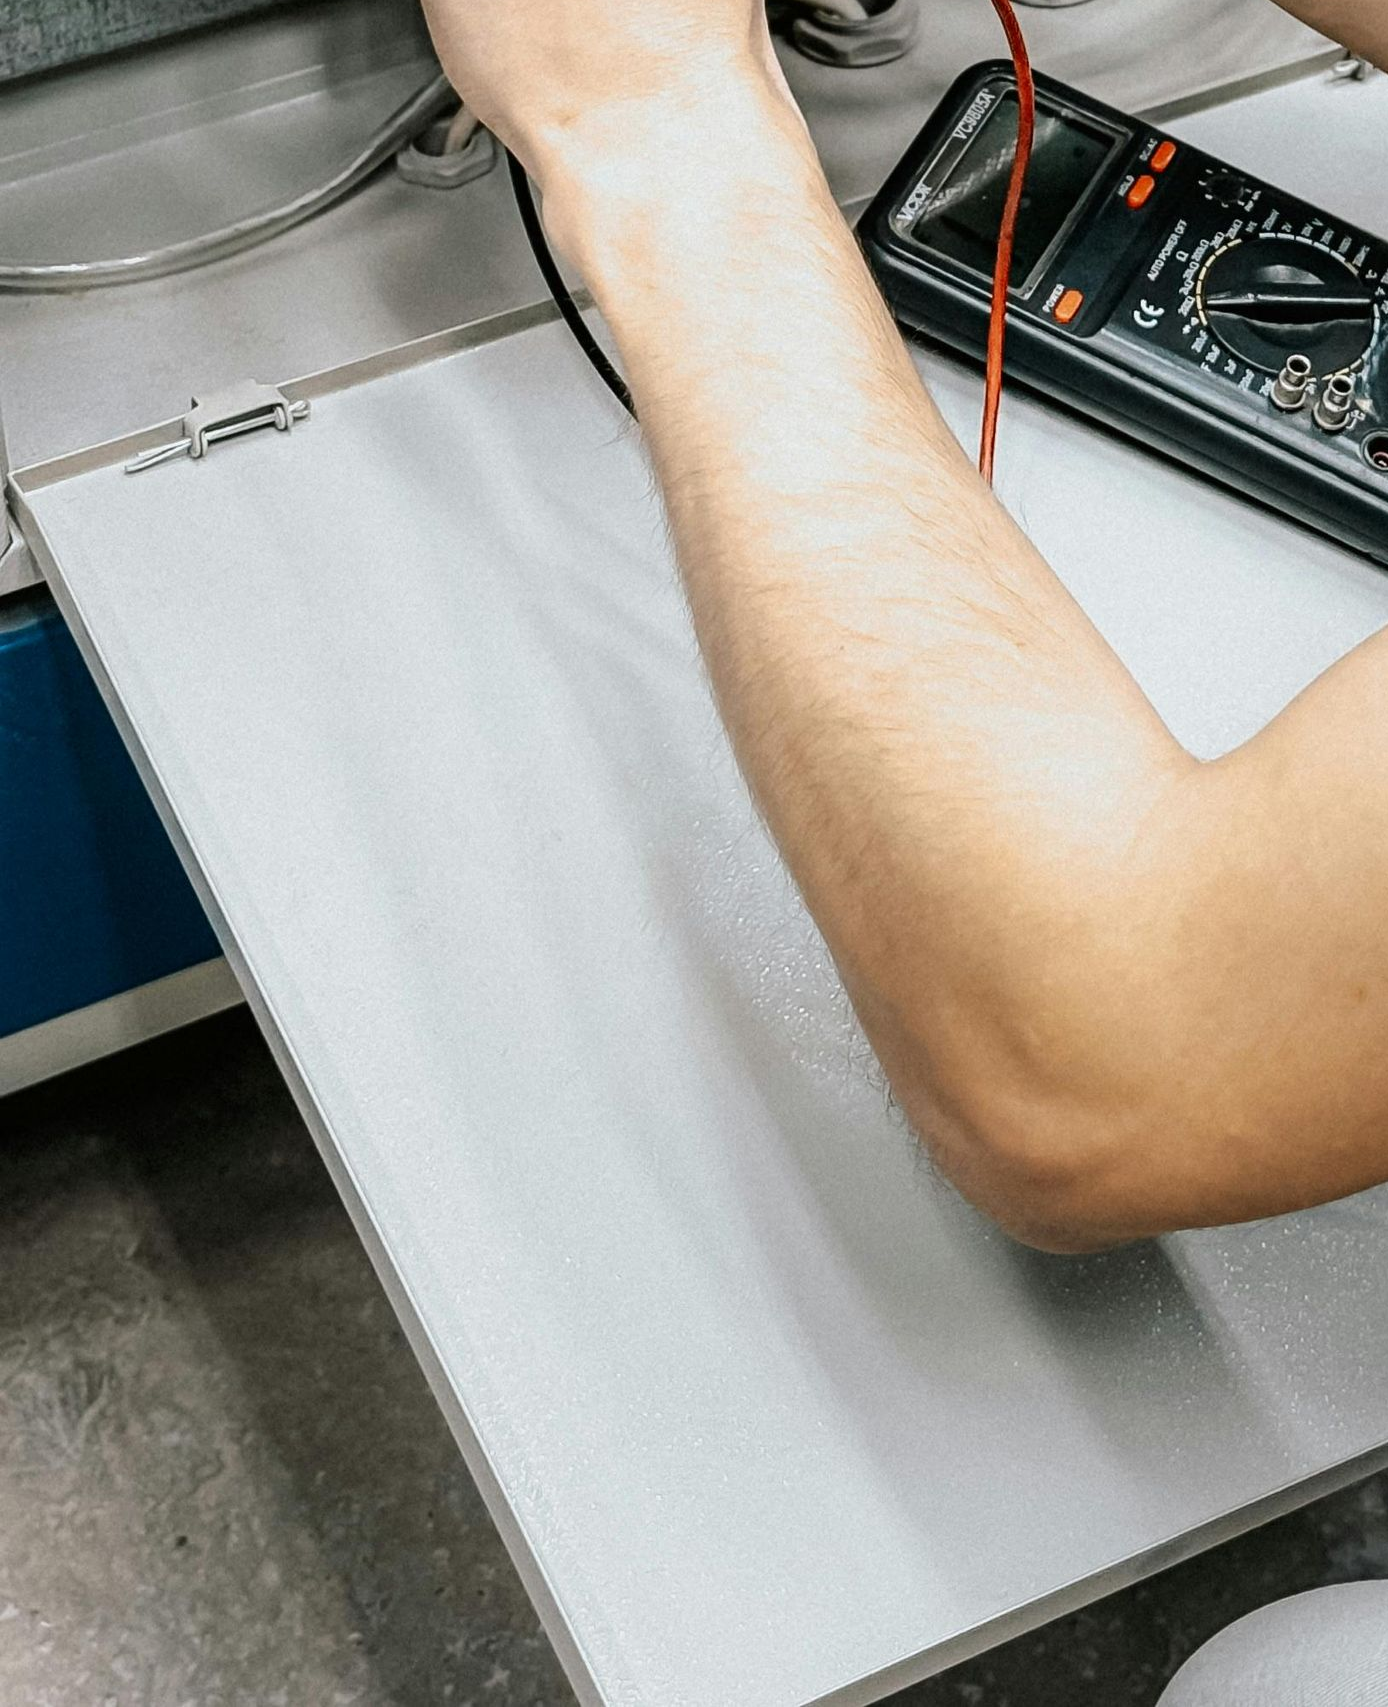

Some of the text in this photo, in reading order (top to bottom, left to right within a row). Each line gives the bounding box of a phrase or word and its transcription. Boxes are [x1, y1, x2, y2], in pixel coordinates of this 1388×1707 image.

[1147, 219, 1188, 281] AUTO POWER OFF
[1042, 283, 1065, 313] POWER
[1133, 299, 1165, 329] CE
